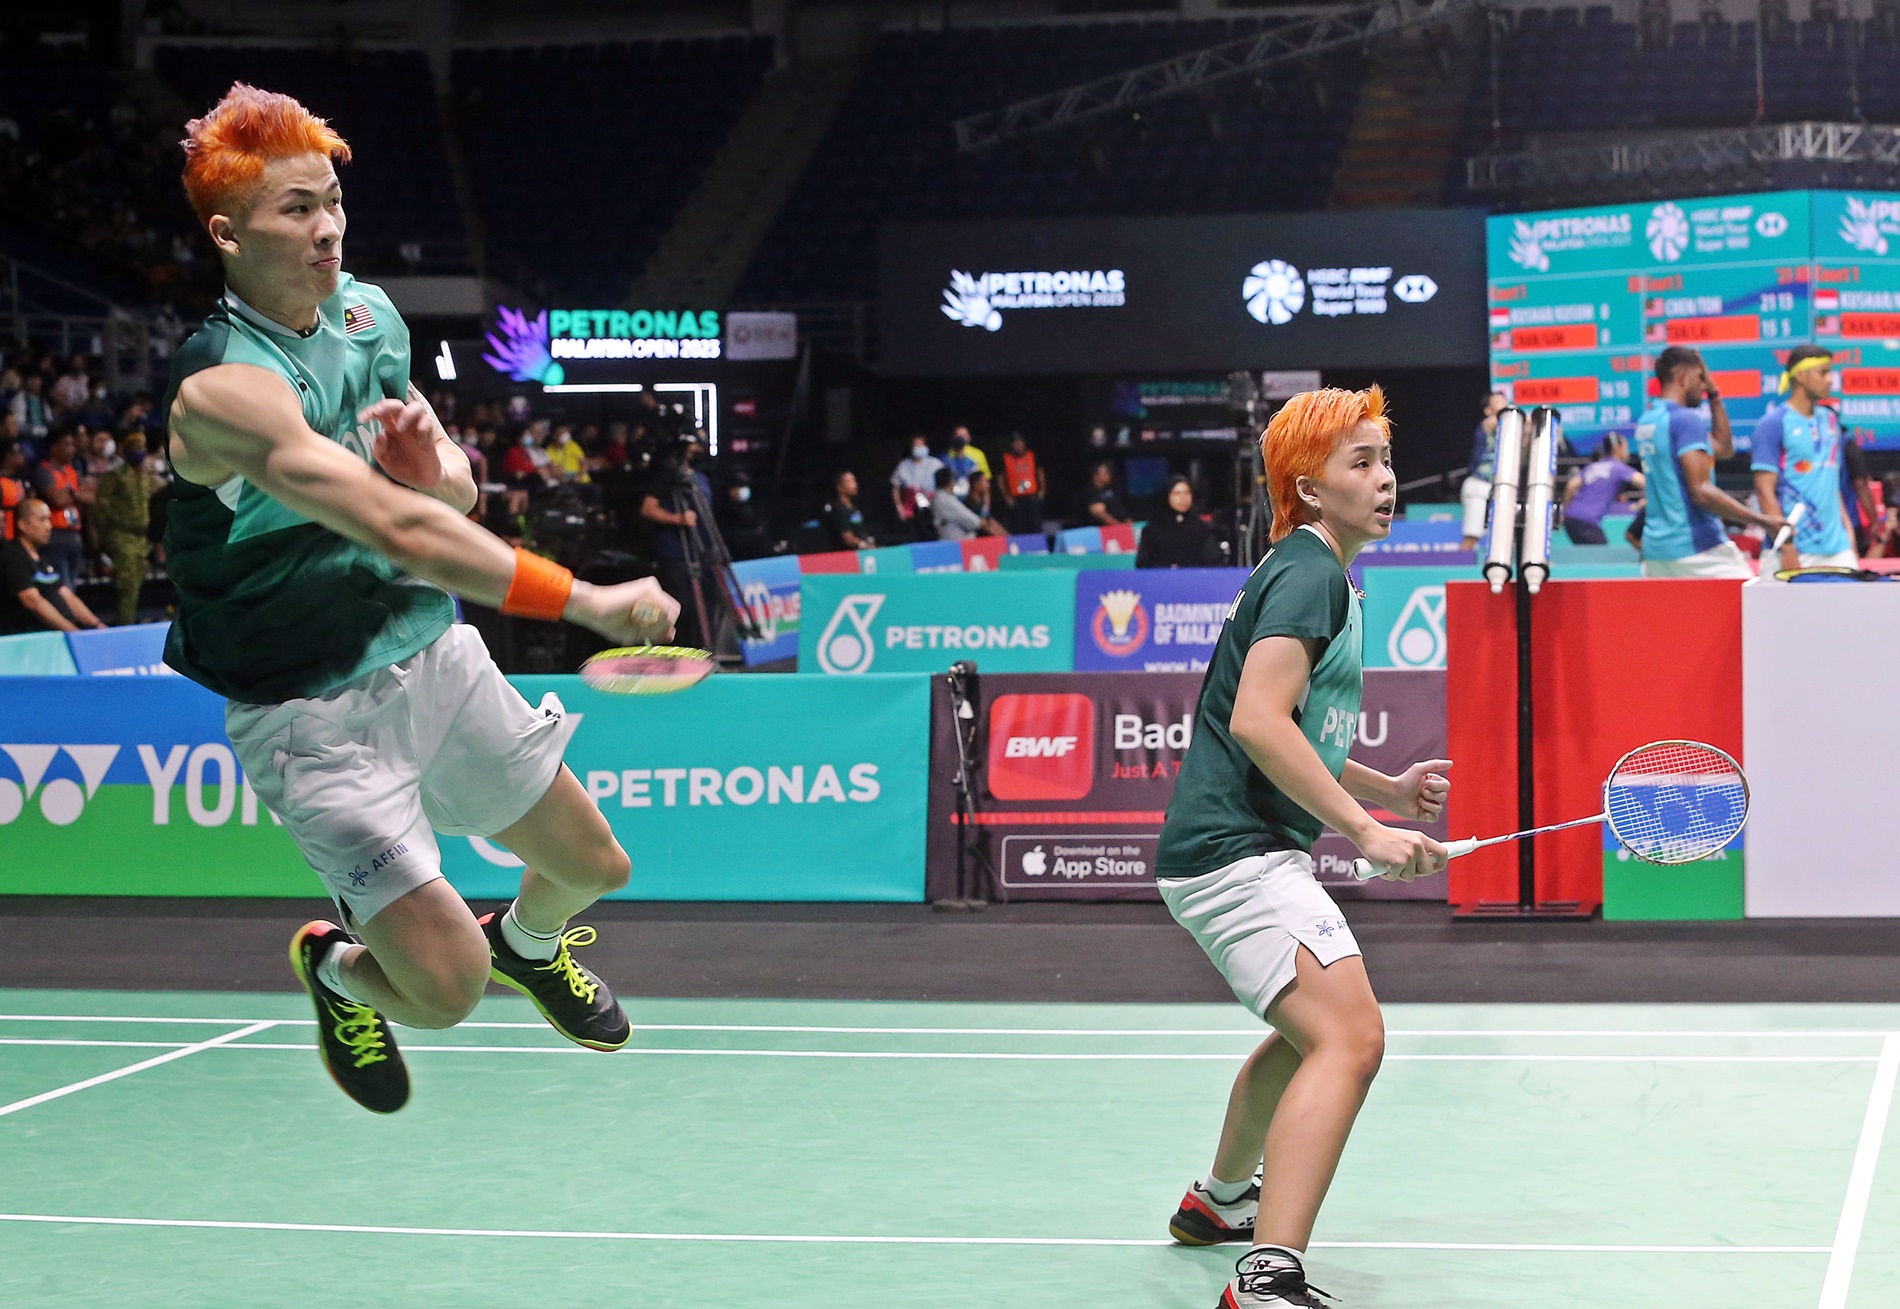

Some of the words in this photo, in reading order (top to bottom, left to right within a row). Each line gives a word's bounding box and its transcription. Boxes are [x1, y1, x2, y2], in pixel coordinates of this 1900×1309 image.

[1538, 213, 1632, 240] PETRONAS
[990, 269, 1126, 296] PETRONAS
[550, 309, 720, 339] PETRONAS
[632, 338, 679, 359] OPEN
[885, 624, 1051, 652] PETRONAS
[1153, 623, 1174, 646] OF
[1175, 623, 1222, 645] MALA
[1319, 706, 1357, 750] PET
[1353, 711, 1389, 748] U
[1004, 735, 1079, 759] BWF
[1111, 761, 1148, 779] Just
[1151, 761, 1168, 779] A
[586, 762, 881, 808] PETRONAS
[371, 842, 409, 872] AFFIN
[1053, 845, 1106, 857] Download
[1106, 846, 1121, 857] on
[1122, 845, 1141, 857] the
[1052, 856, 1092, 879] App
[1094, 856, 1147, 876] Store
[1320, 854, 1355, 878] Play
